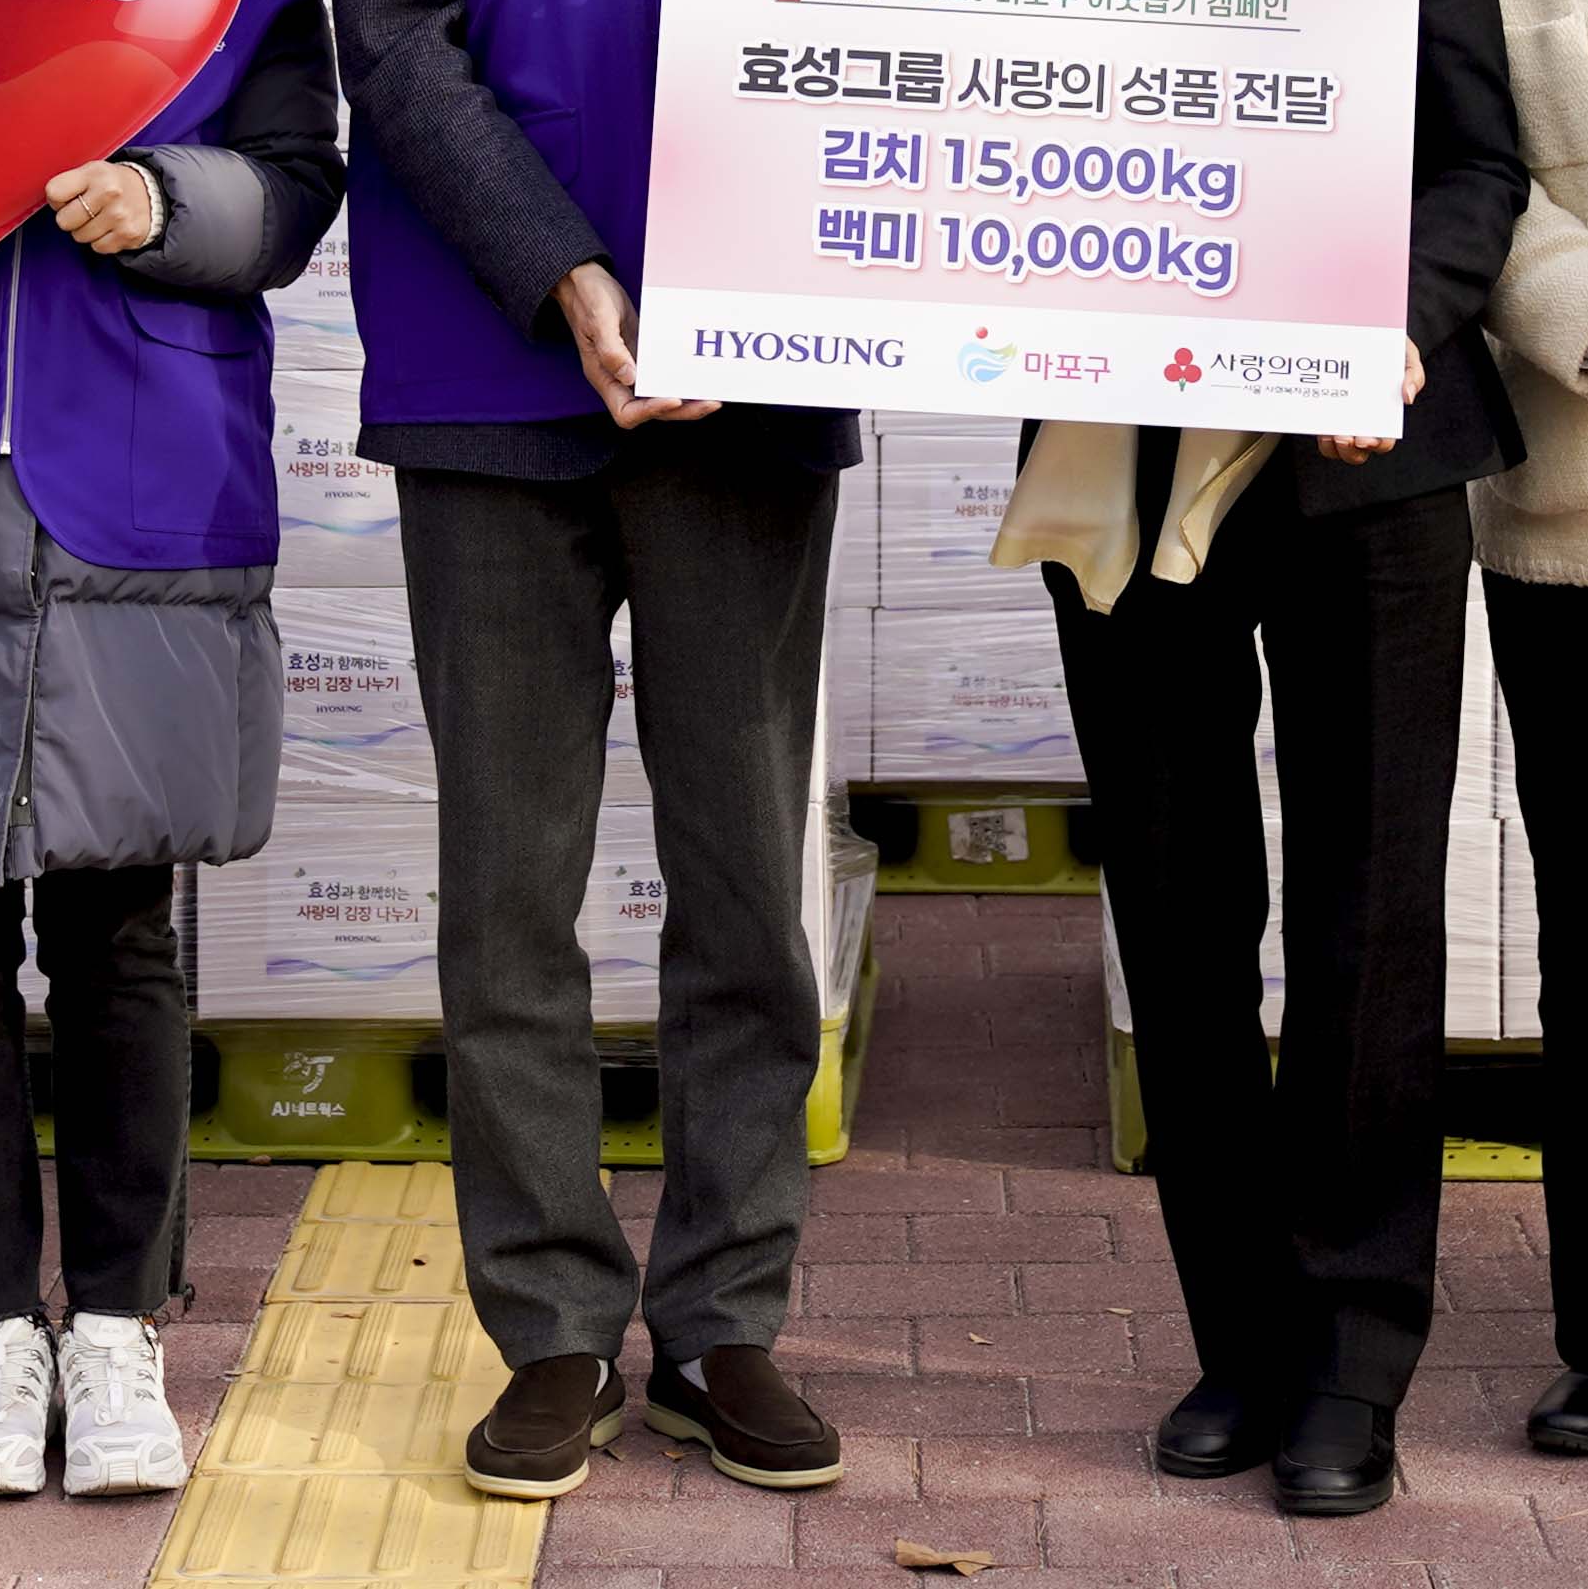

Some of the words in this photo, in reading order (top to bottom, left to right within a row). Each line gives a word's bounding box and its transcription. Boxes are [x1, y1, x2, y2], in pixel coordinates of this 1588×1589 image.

[739, 42, 946, 106] 효성그룹
[958, 54, 1106, 114] 사랑의
[1121, 65, 1219, 120] 성품
[1233, 72, 1333, 125] 전달
[823, 130, 921, 185] 김치
[943, 138, 1237, 212] 15,000kg
[819, 208, 917, 264] 백미
[940, 217, 1233, 289] 10,000kg
[693, 328, 905, 369] HYOSUNG
[1024, 351, 1111, 384] 마포구
[1210, 353, 1350, 384] 사랑의열매
[296, 438, 343, 457] 효성과
[287, 461, 329, 478] 사랑의
[333, 461, 362, 478] 김장
[366, 462, 394, 478] 나누
[288, 652, 334, 672] 효성과
[337, 655, 390, 671] 함께하는
[325, 676, 353, 692] 김장
[357, 675, 399, 692] 나누기
[307, 881, 354, 901] 효성과
[357, 885, 410, 901] 함께하는
[297, 905, 340, 921] 사랑의
[344, 905, 372, 922] 김장
[377, 906, 419, 923] 나누기
[619, 903, 661, 920] 사랑의
